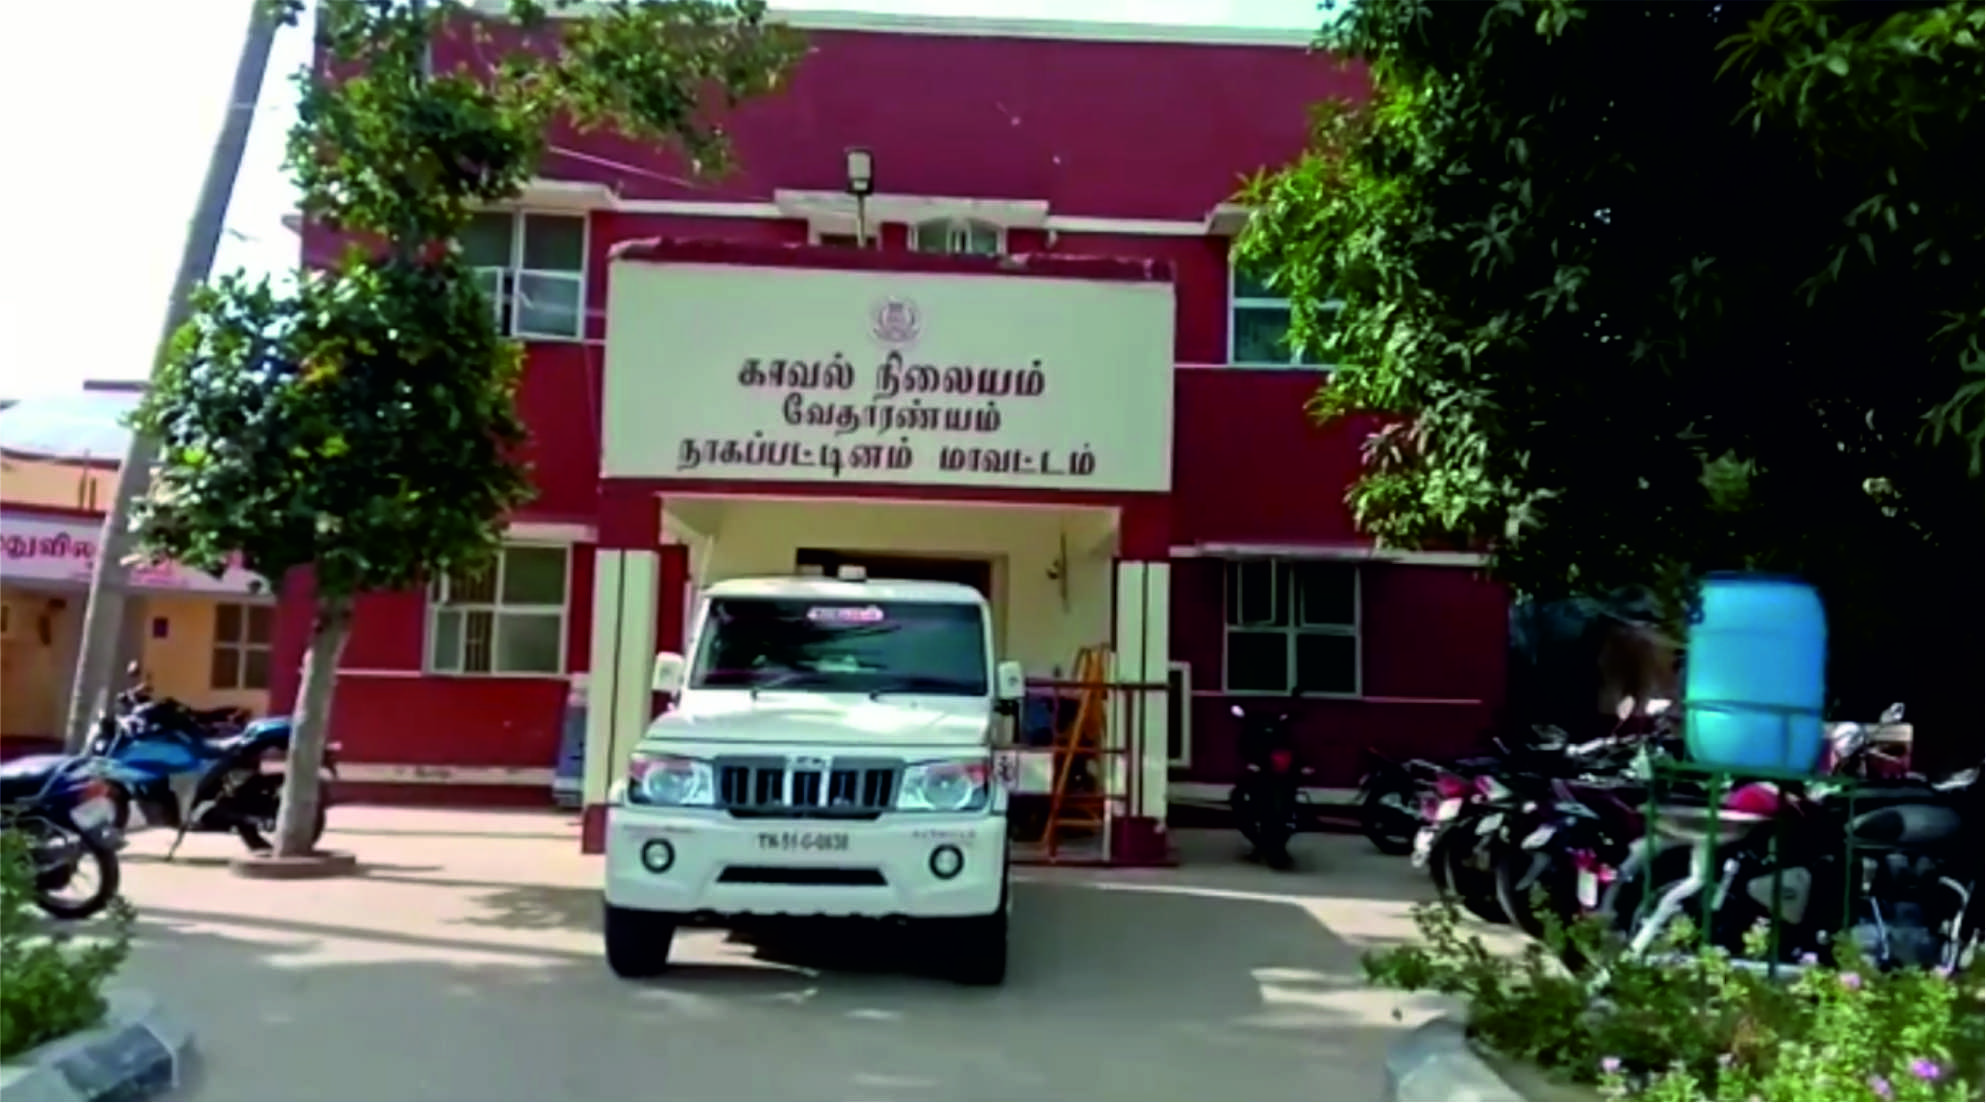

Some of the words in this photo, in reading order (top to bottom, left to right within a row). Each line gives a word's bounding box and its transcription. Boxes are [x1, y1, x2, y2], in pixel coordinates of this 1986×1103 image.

[738, 353, 856, 389] காவல்
[873, 351, 1046, 398] நிலையம்
[782, 392, 1002, 436] வேதாரண்யம்
[677, 431, 914, 477] நாகப்பட்டினம்
[938, 442, 1098, 476] மாவட்டம்
